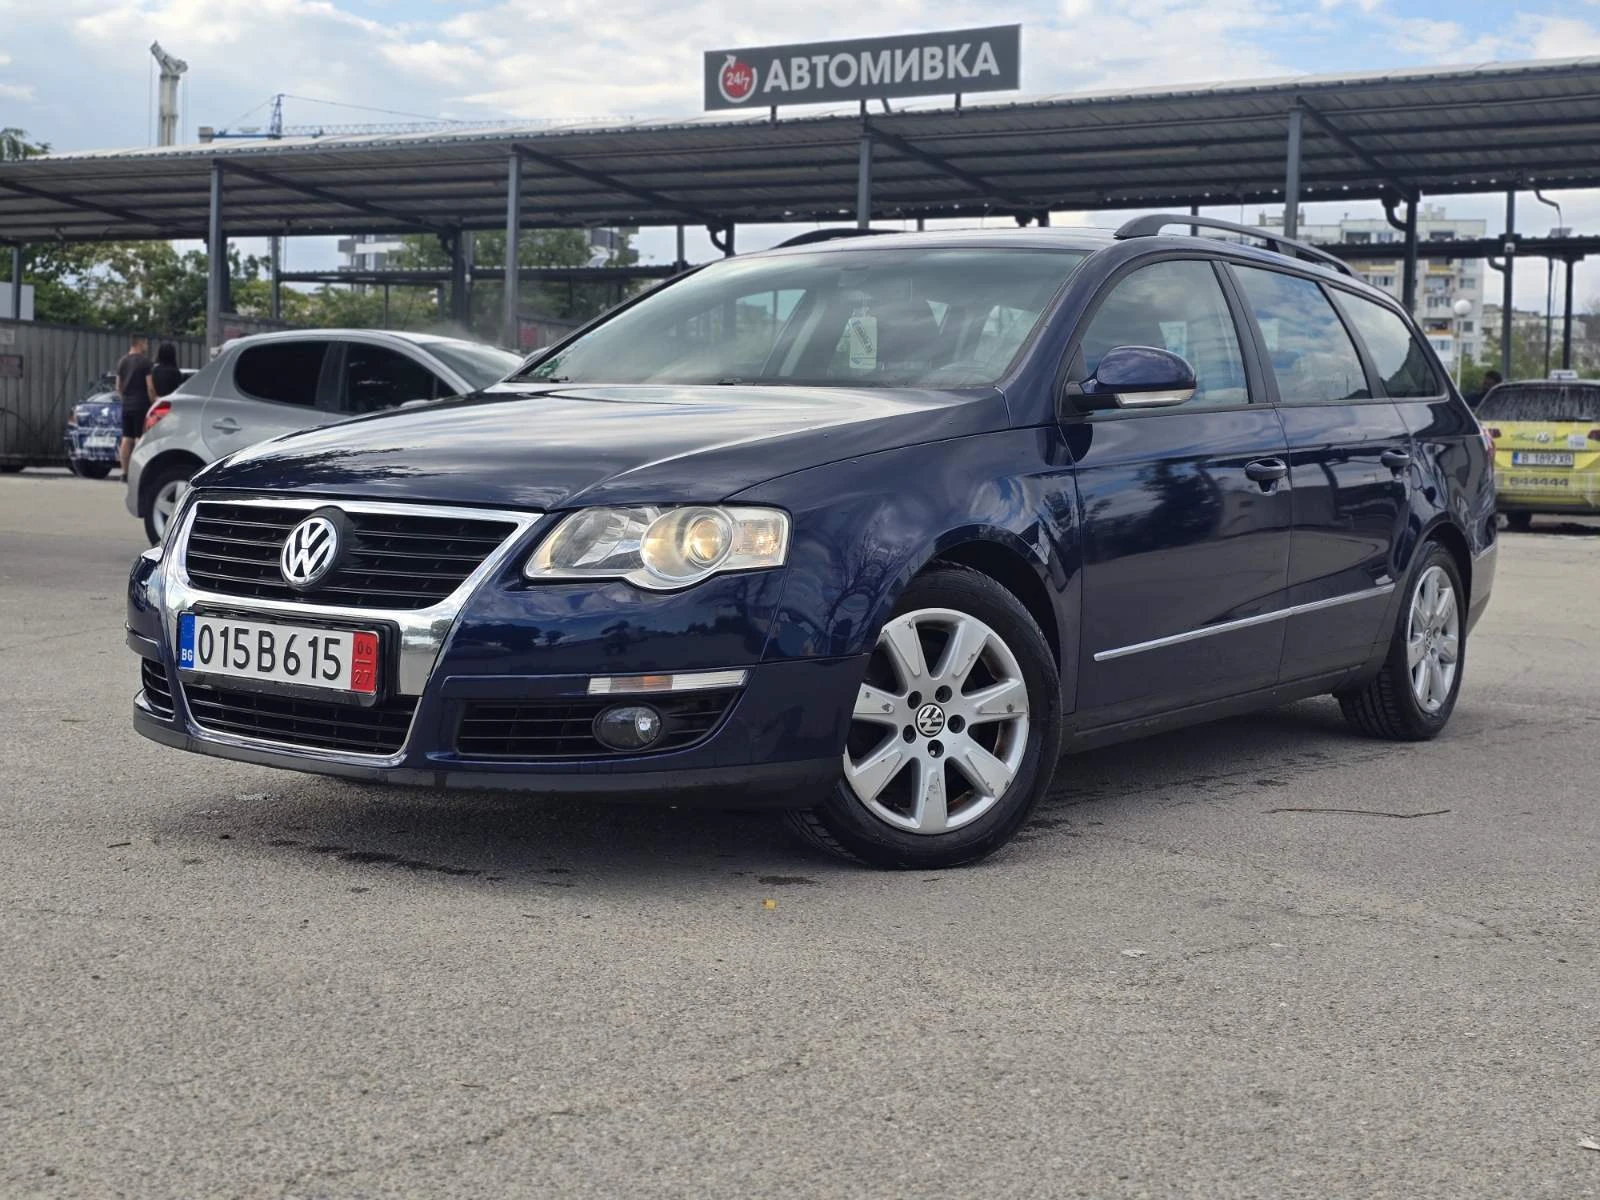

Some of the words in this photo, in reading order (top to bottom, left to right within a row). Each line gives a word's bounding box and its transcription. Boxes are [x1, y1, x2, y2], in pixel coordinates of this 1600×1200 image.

[726, 71, 750, 91] 24/7
[763, 41, 1001, 93] АВТОМИВКА
[181, 648, 193, 662] BG
[198, 624, 341, 681] 015B615
[357, 641, 373, 656] 06
[353, 669, 370, 685] 27
